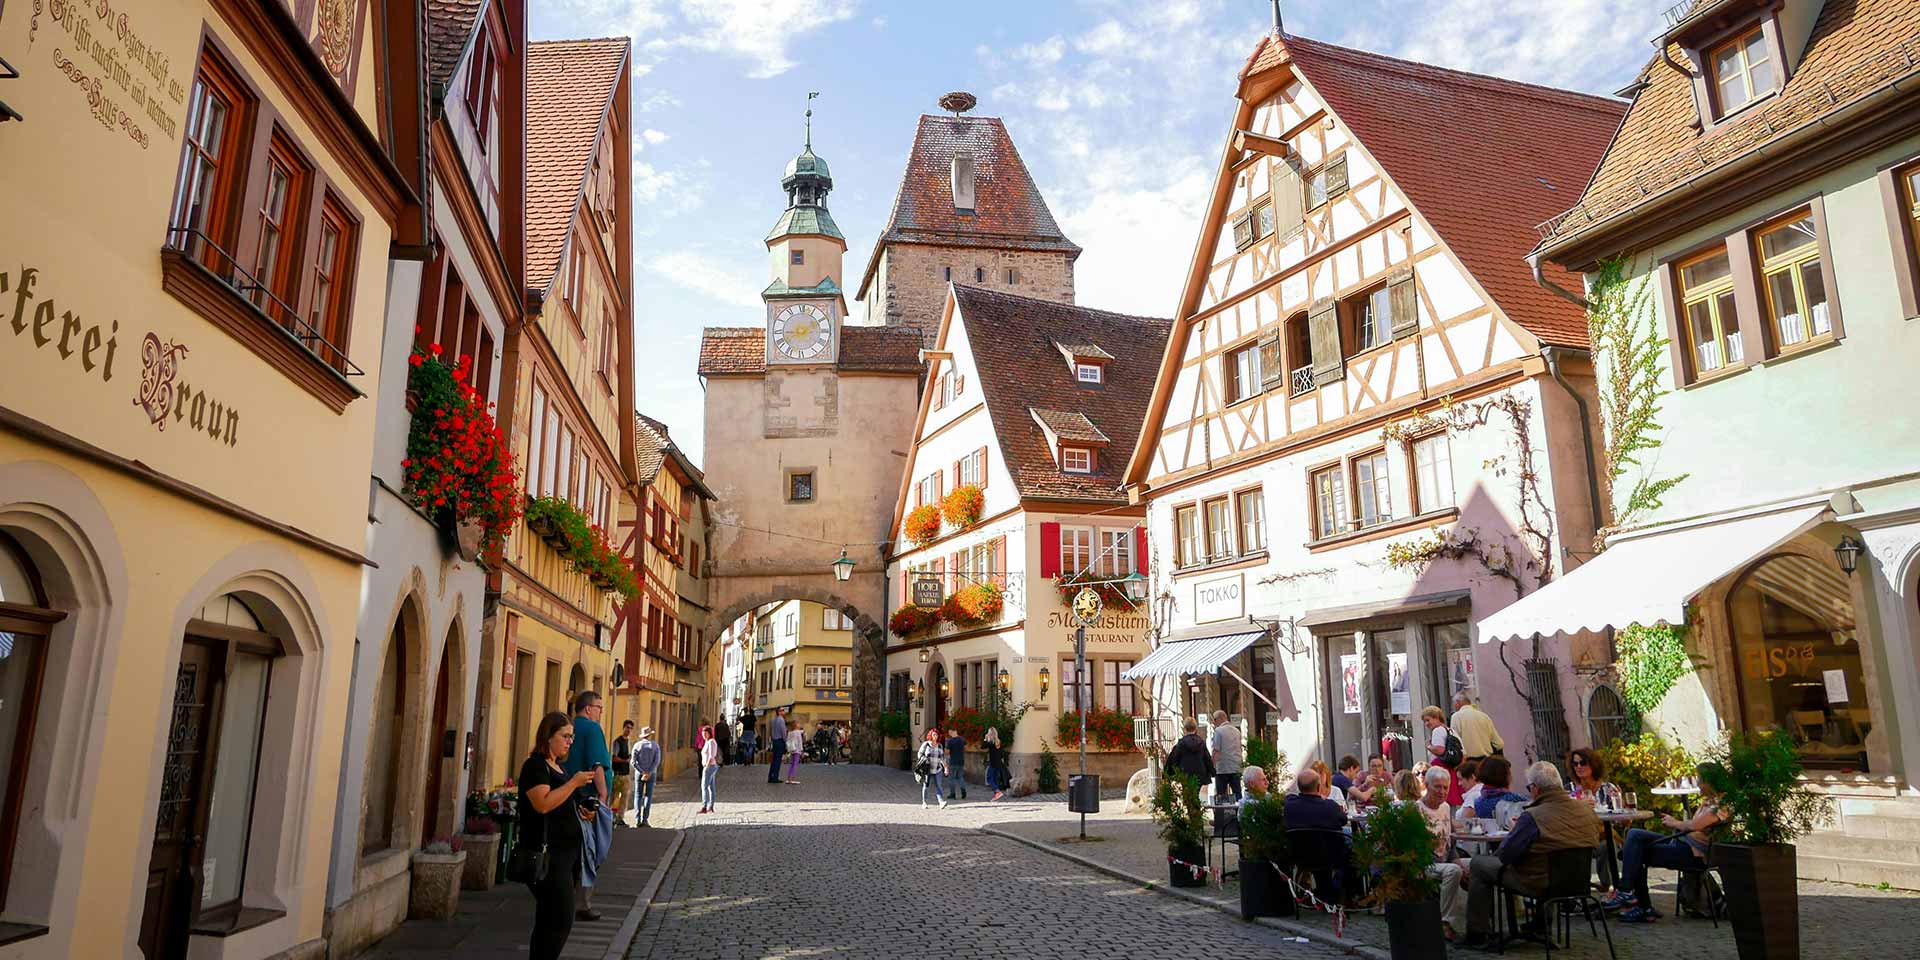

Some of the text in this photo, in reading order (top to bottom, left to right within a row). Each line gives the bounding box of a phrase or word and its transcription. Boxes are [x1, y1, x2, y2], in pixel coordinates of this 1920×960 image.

[75, 16, 91, 53] ihn
[91, 39, 119, 79] auch
[88, 78, 118, 124] Haus
[133, 332, 239, 447] Braun
[1067, 633, 1135, 643] RSTAURANT
